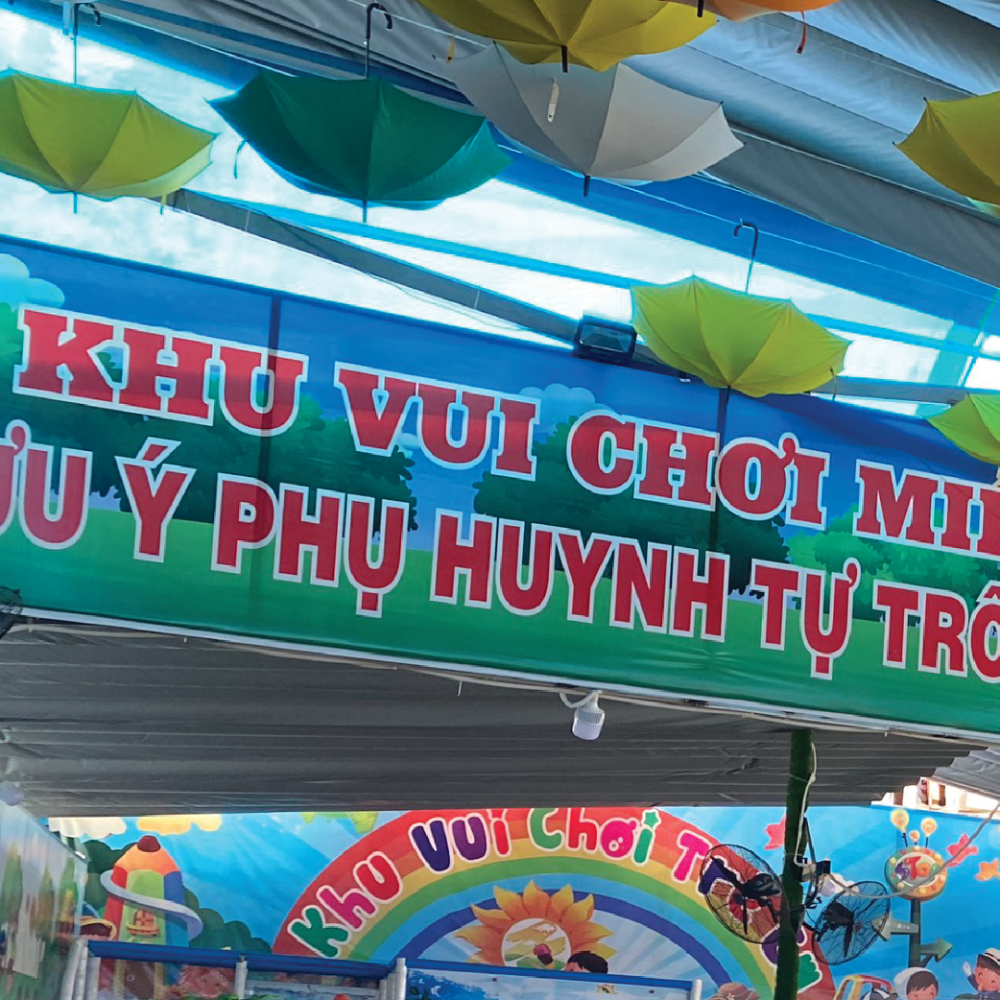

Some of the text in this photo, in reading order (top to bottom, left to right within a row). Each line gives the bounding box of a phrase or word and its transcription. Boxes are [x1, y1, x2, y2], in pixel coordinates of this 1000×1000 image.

[14, 303, 307, 436] KHU
[335, 363, 540, 481] VUI
[567, 408, 830, 531] CHƠI
[116, 437, 196, 563] Ý
[211, 472, 409, 618] PHỤ
[429, 508, 730, 642] HUYNH
[751, 557, 861, 679] TỰ
